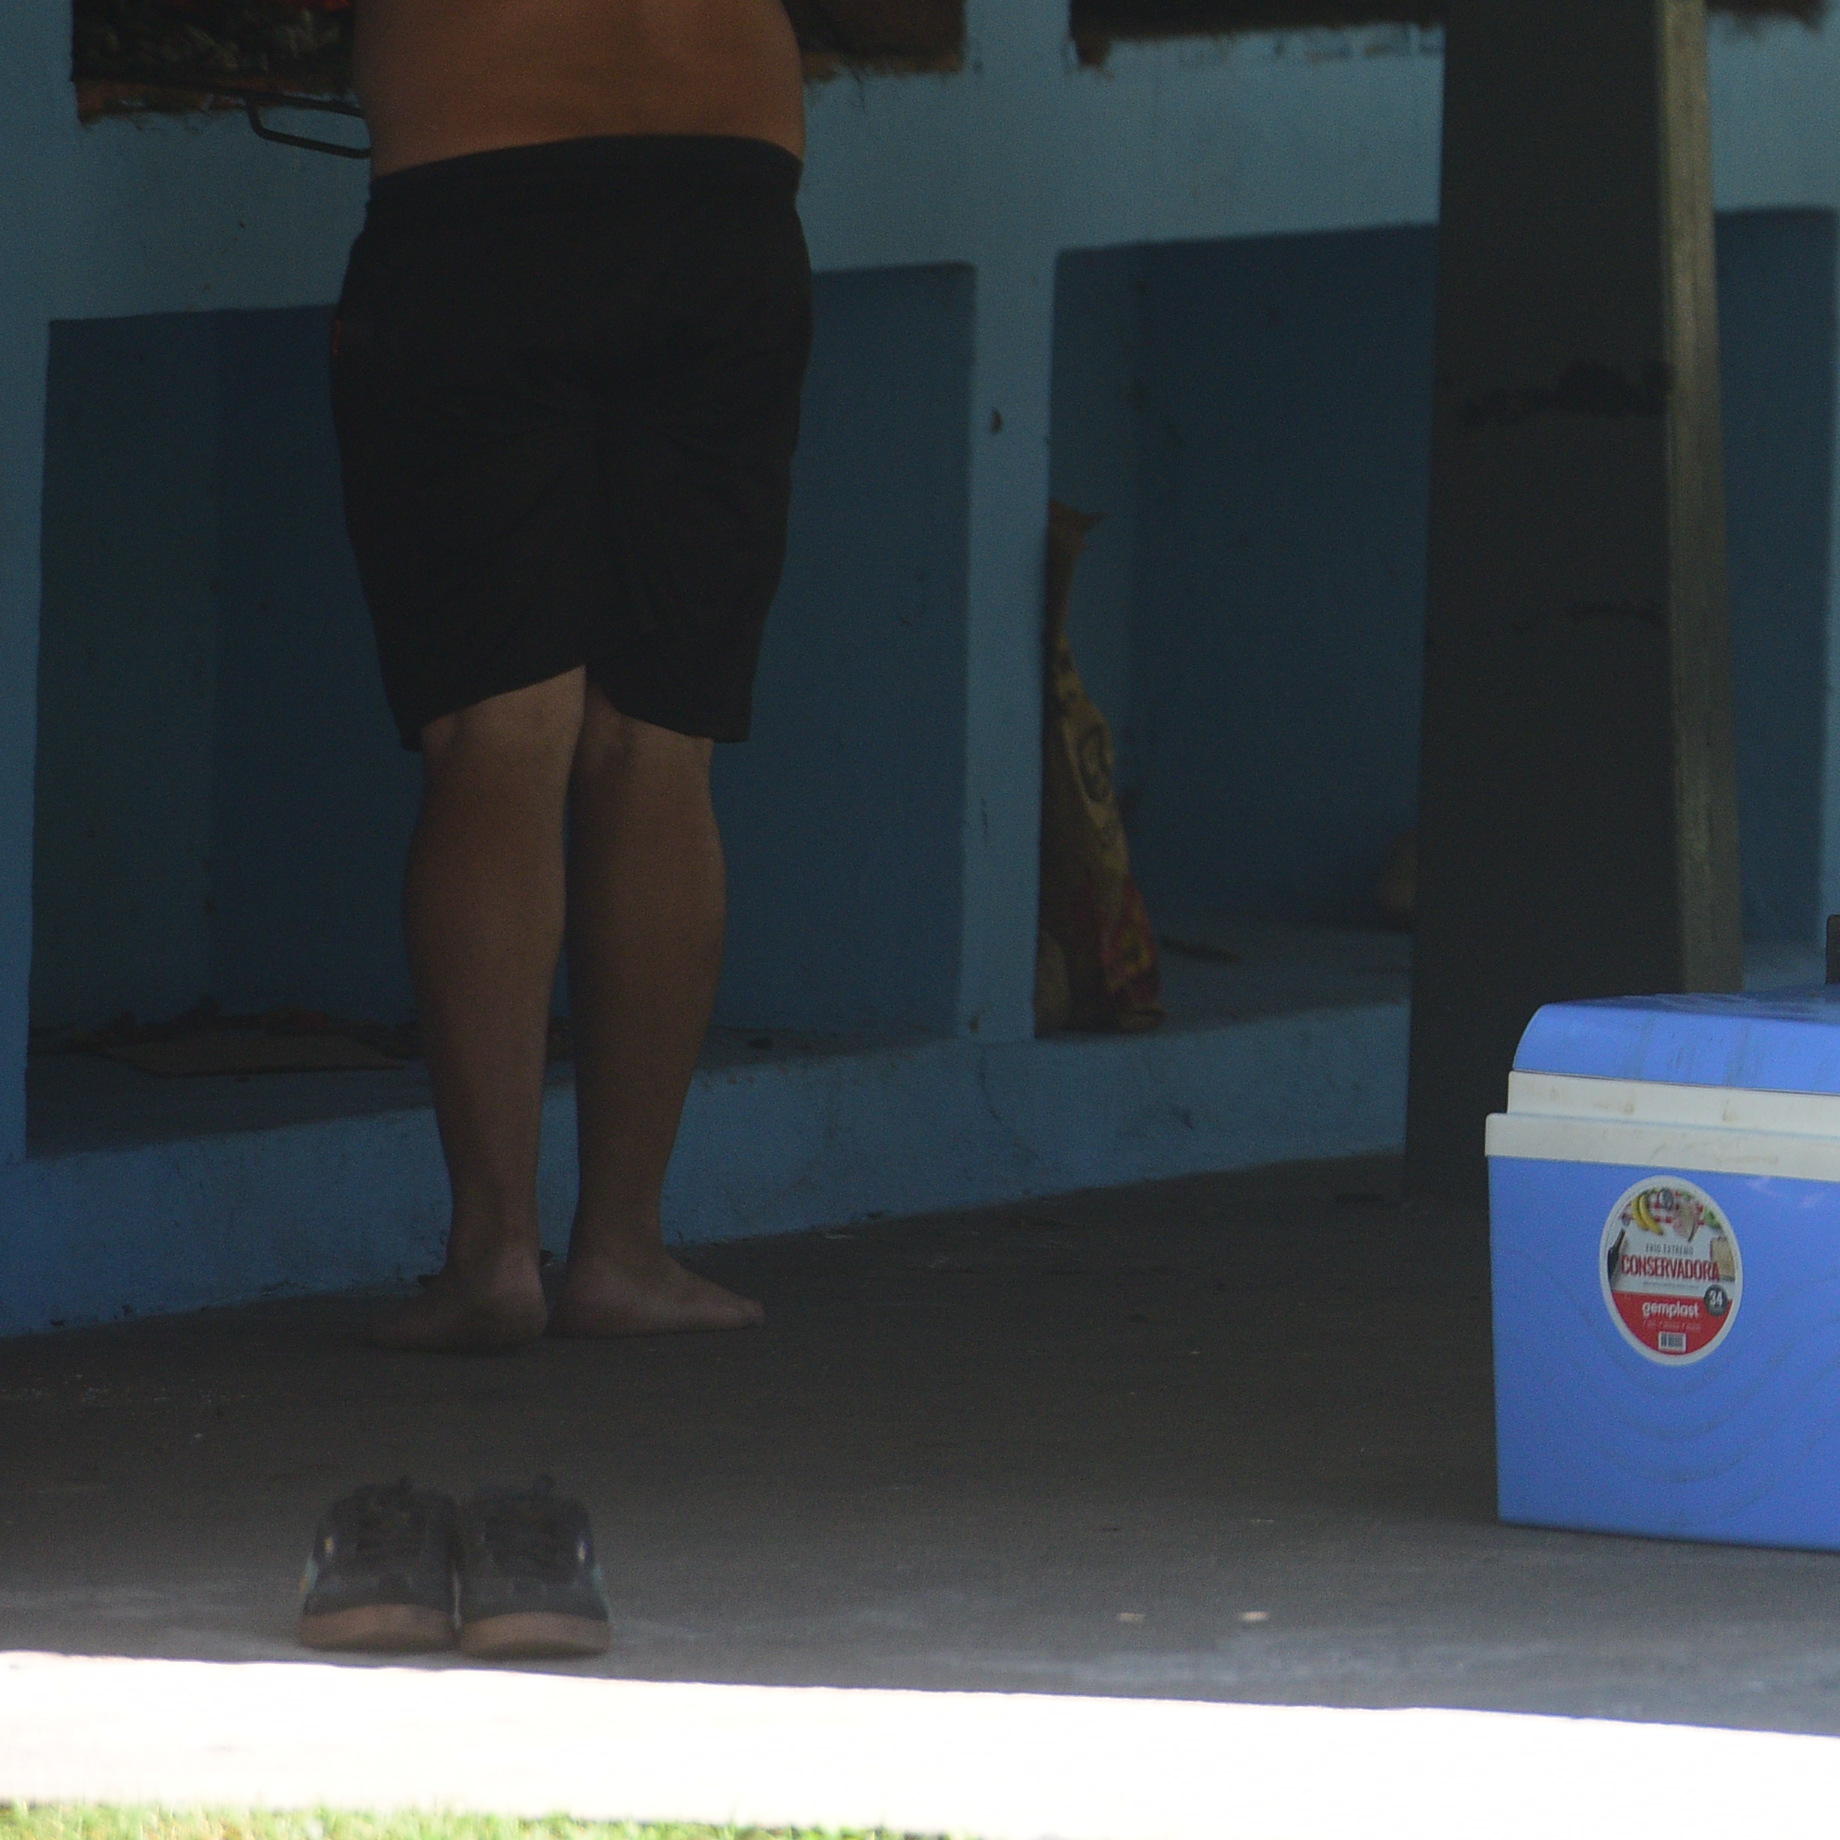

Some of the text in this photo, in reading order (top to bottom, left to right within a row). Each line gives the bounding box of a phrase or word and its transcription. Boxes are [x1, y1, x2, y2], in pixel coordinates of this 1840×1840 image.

[1620, 1254, 1720, 1282] CONSERVADORA
[1709, 1290, 1723, 1306] 34
[1642, 1301, 1699, 1319] gemplast
